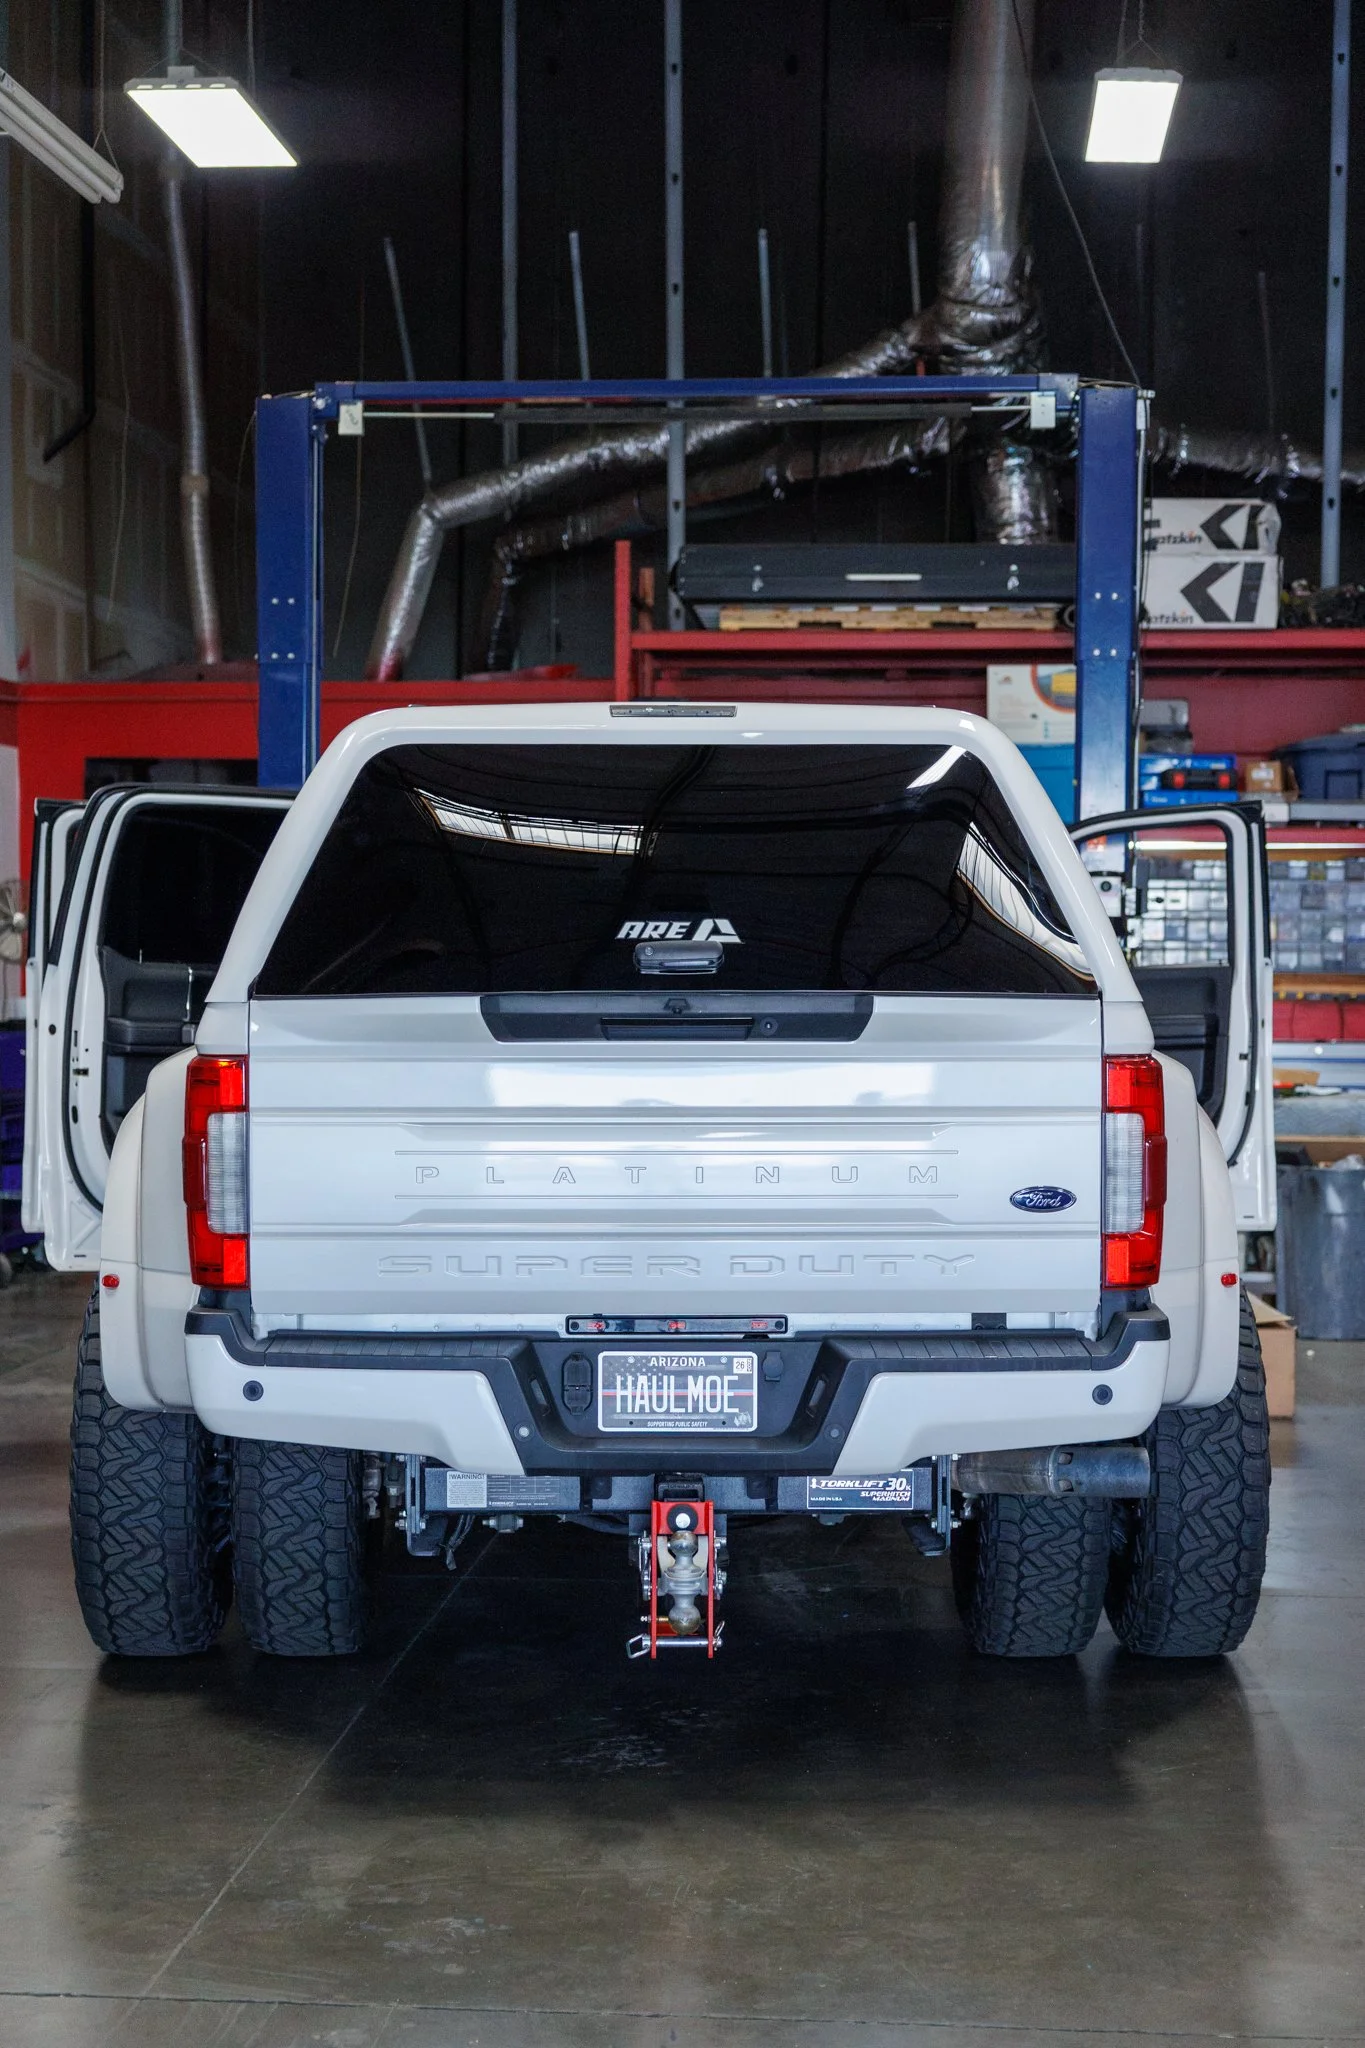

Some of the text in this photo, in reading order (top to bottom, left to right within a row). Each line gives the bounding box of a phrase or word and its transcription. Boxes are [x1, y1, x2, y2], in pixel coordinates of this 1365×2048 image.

[1153, 530, 1202, 545] atzkin
[615, 920, 692, 939] ARE
[415, 1165, 938, 1184] PLATINUM
[1025, 1191, 1062, 1207] Ford
[377, 1254, 976, 1278] SUPER DUTY
[650, 1357, 706, 1367] ARIZONA
[735, 1360, 745, 1370] 26
[616, 1375, 740, 1413] HAULMOE
[820, 1480, 887, 1488] TORKLIFT
